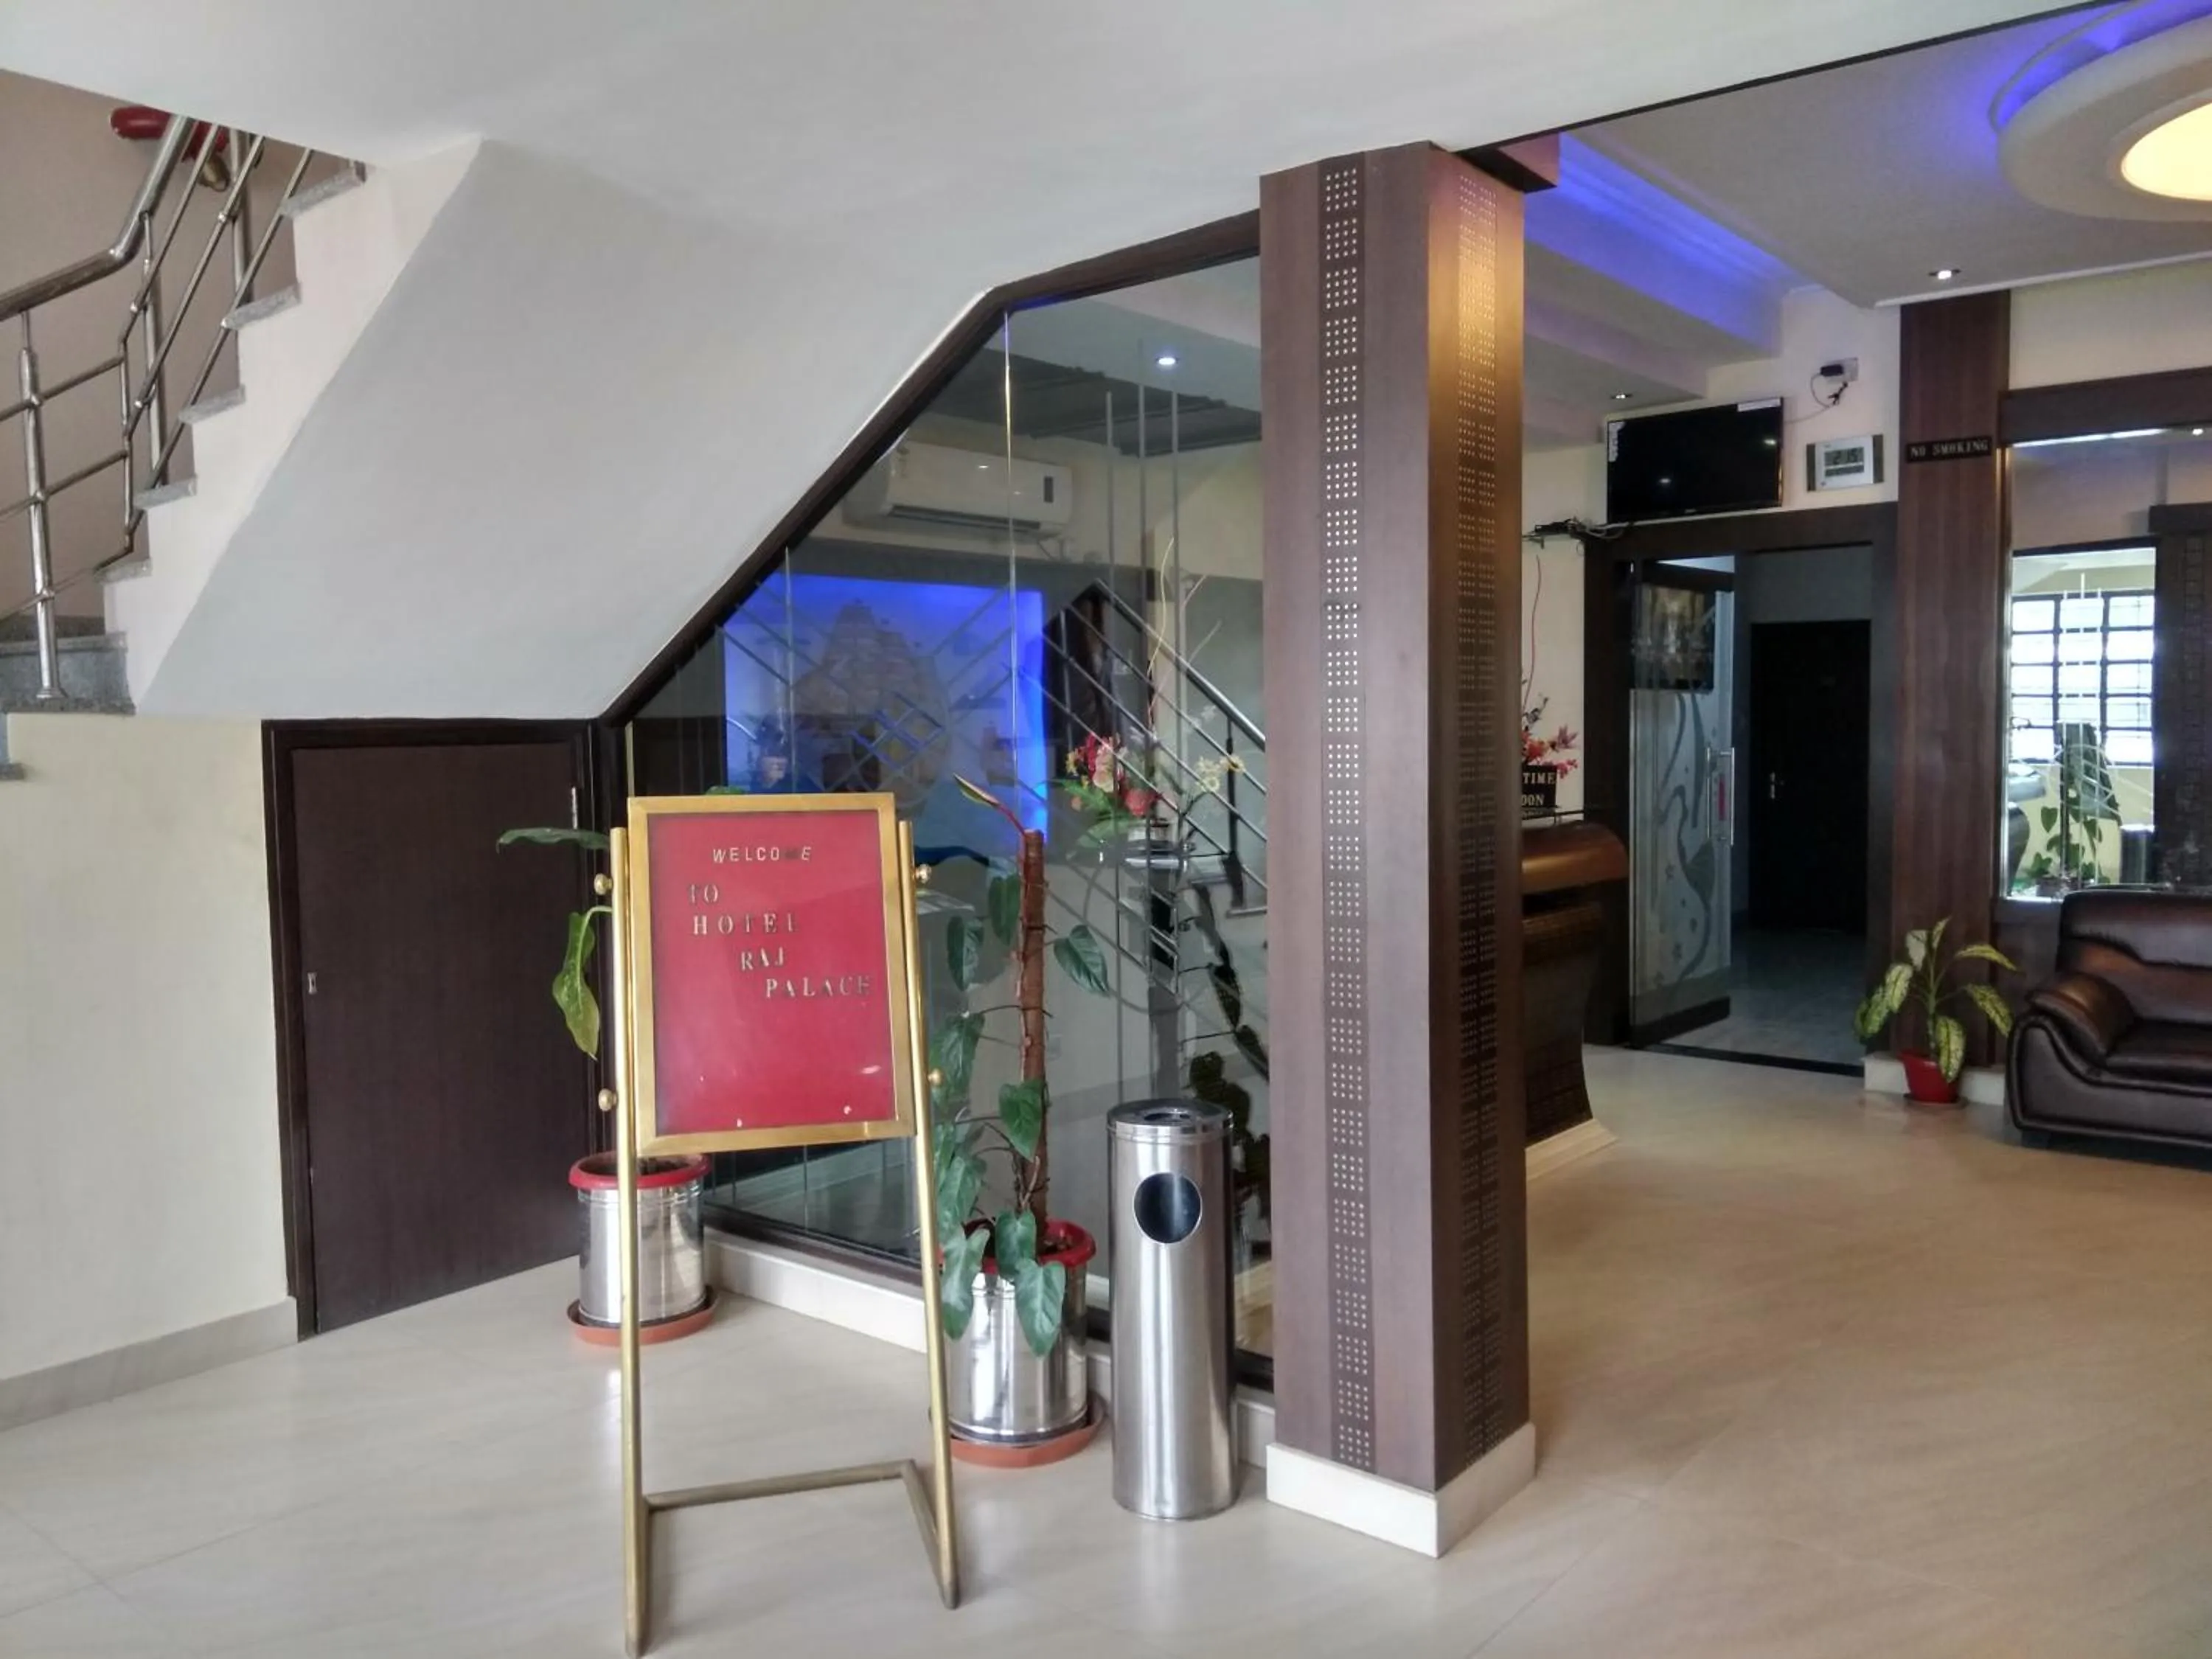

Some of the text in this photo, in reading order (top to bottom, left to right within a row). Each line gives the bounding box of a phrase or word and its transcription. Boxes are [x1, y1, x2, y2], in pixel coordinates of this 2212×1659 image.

[1933, 439, 1989, 455] SMOKING
[1523, 772, 1556, 784] TIME
[741, 947, 784, 971] RAJ
[766, 975, 870, 998] PALACE
